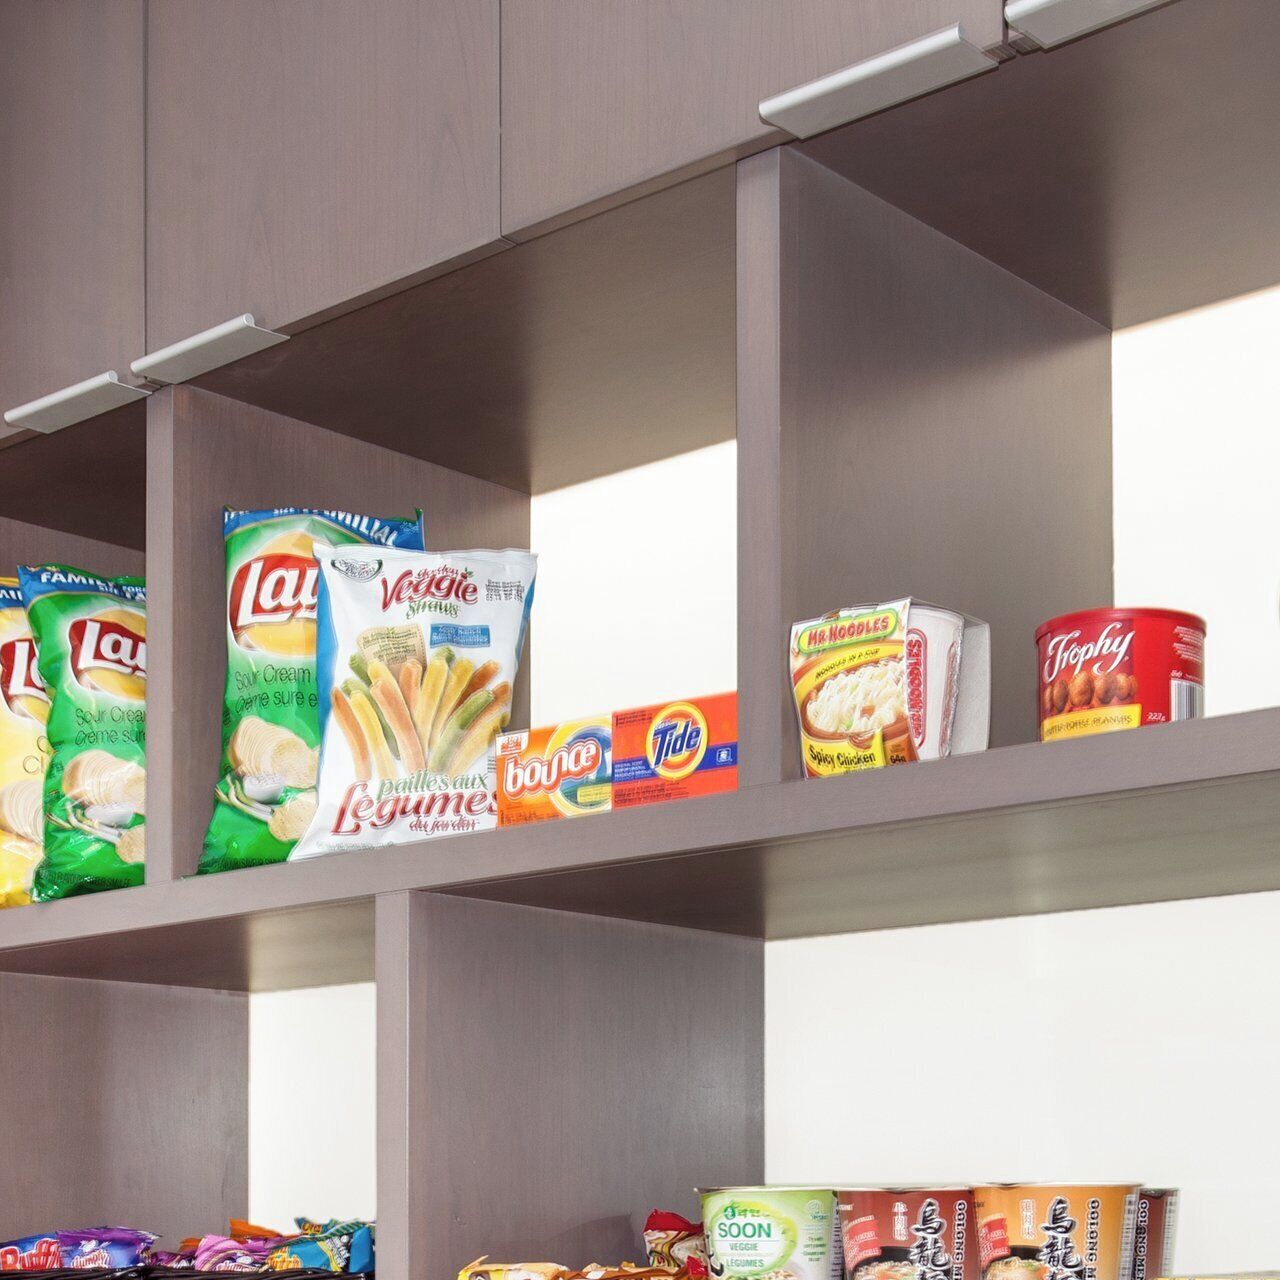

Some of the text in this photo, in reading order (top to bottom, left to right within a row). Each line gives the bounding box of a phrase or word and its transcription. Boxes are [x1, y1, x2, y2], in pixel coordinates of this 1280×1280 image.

[41, 572, 115, 588] FAMILY
[381, 569, 478, 612] Veggie
[1043, 621, 1136, 684] Trophy
[235, 663, 311, 691] Sour Cream
[75, 705, 146, 727] Sour Crea
[122, 729, 146, 743] sur
[653, 720, 702, 769] Tide
[505, 740, 599, 795] bounce
[809, 743, 877, 769] Spicy Chicken
[377, 769, 489, 802] pailles aux
[718, 1222, 772, 1239] SOON
[954, 1200, 967, 1263] OOLONG
[1086, 1199, 1100, 1262] OOLONG
[729, 1242, 759, 1252] VEGGIE
